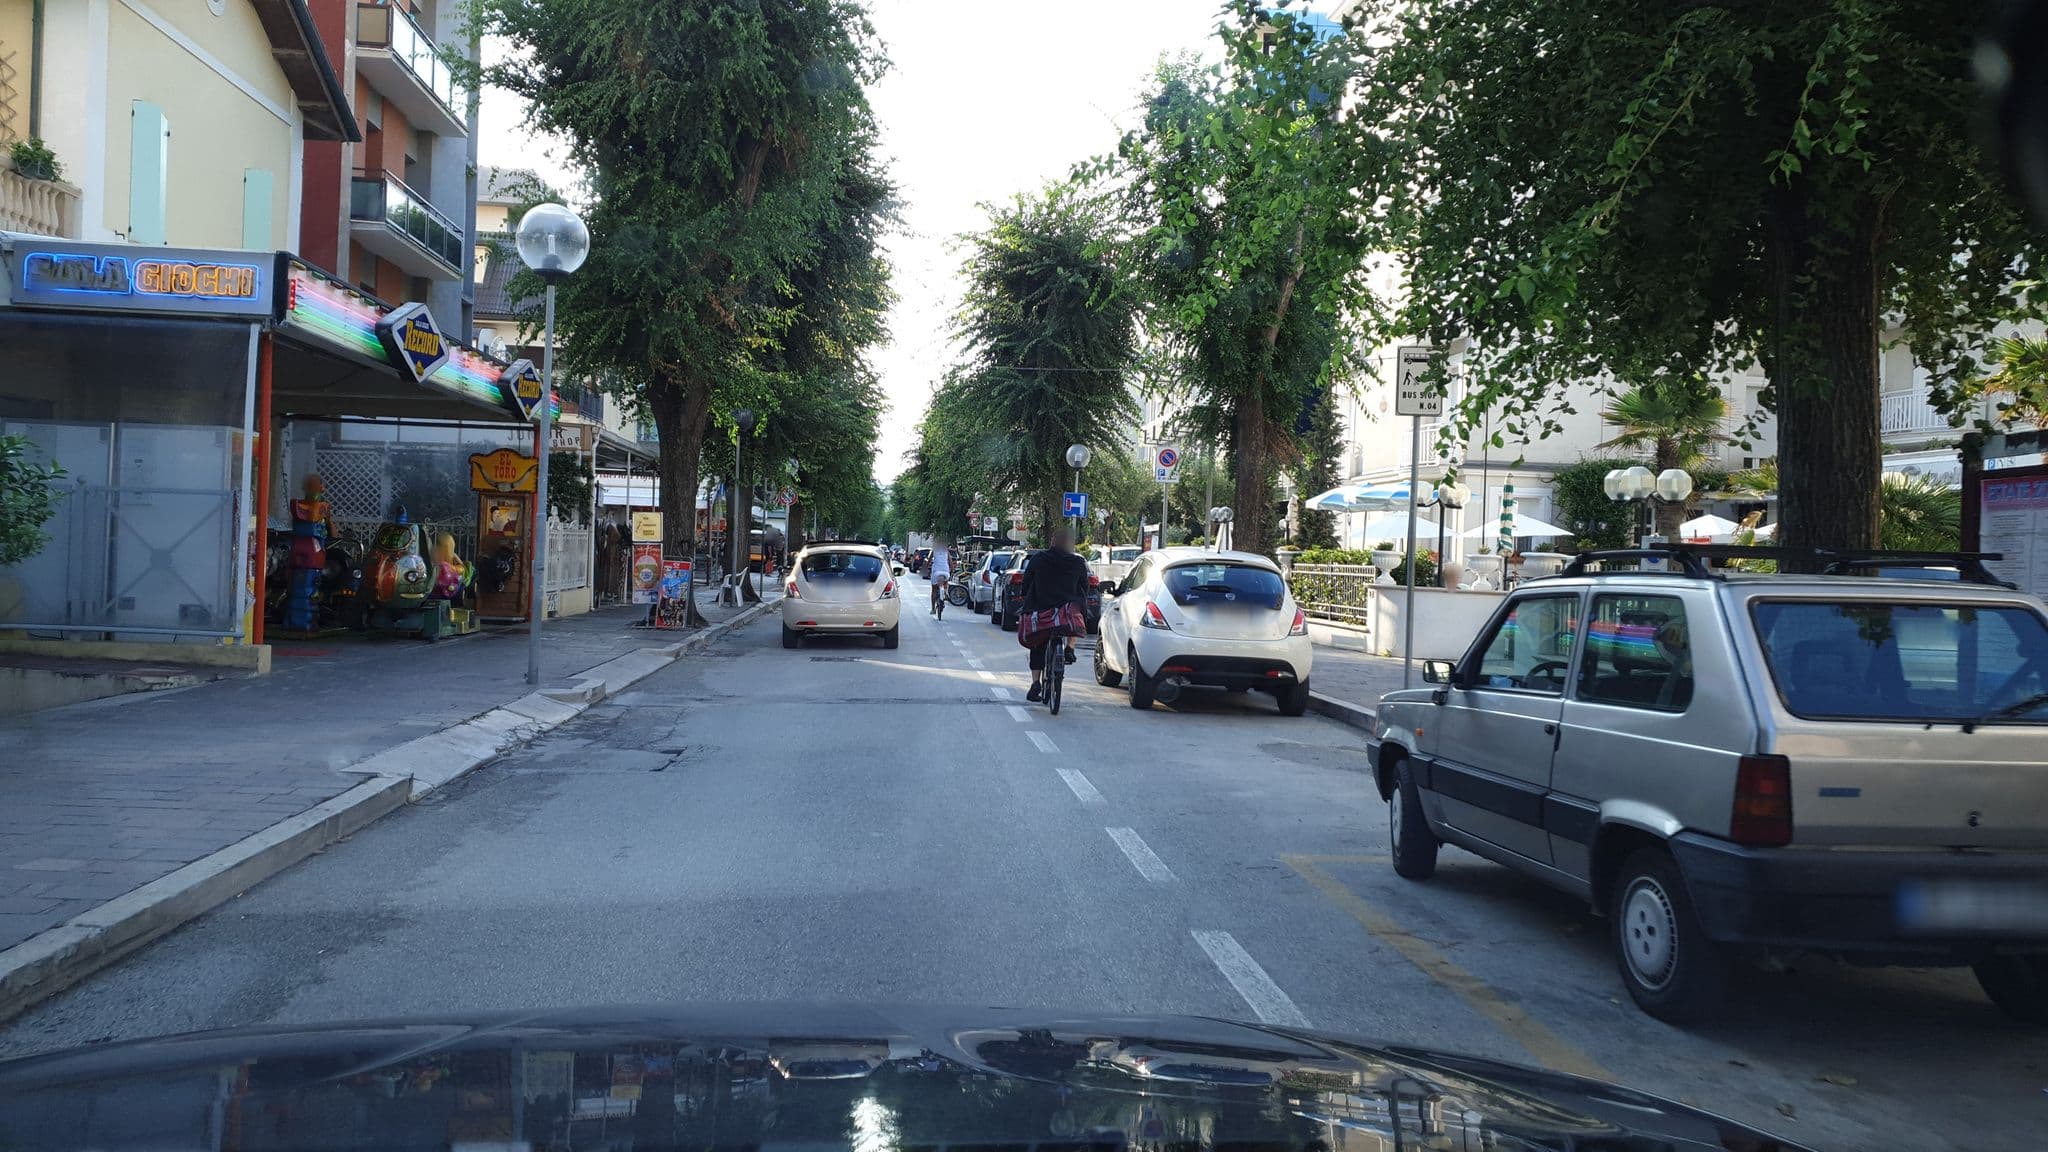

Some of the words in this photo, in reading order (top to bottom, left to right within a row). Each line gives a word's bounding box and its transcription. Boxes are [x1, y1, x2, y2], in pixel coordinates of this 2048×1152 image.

[136, 261, 254, 297] GIOCHI
[404, 320, 440, 356] RECORD
[518, 374, 540, 399] RECORD
[1403, 391, 1417, 399] BUS
[1419, 402, 1437, 410] N.04
[500, 453, 511, 466] EL
[494, 466, 517, 479] TORO
